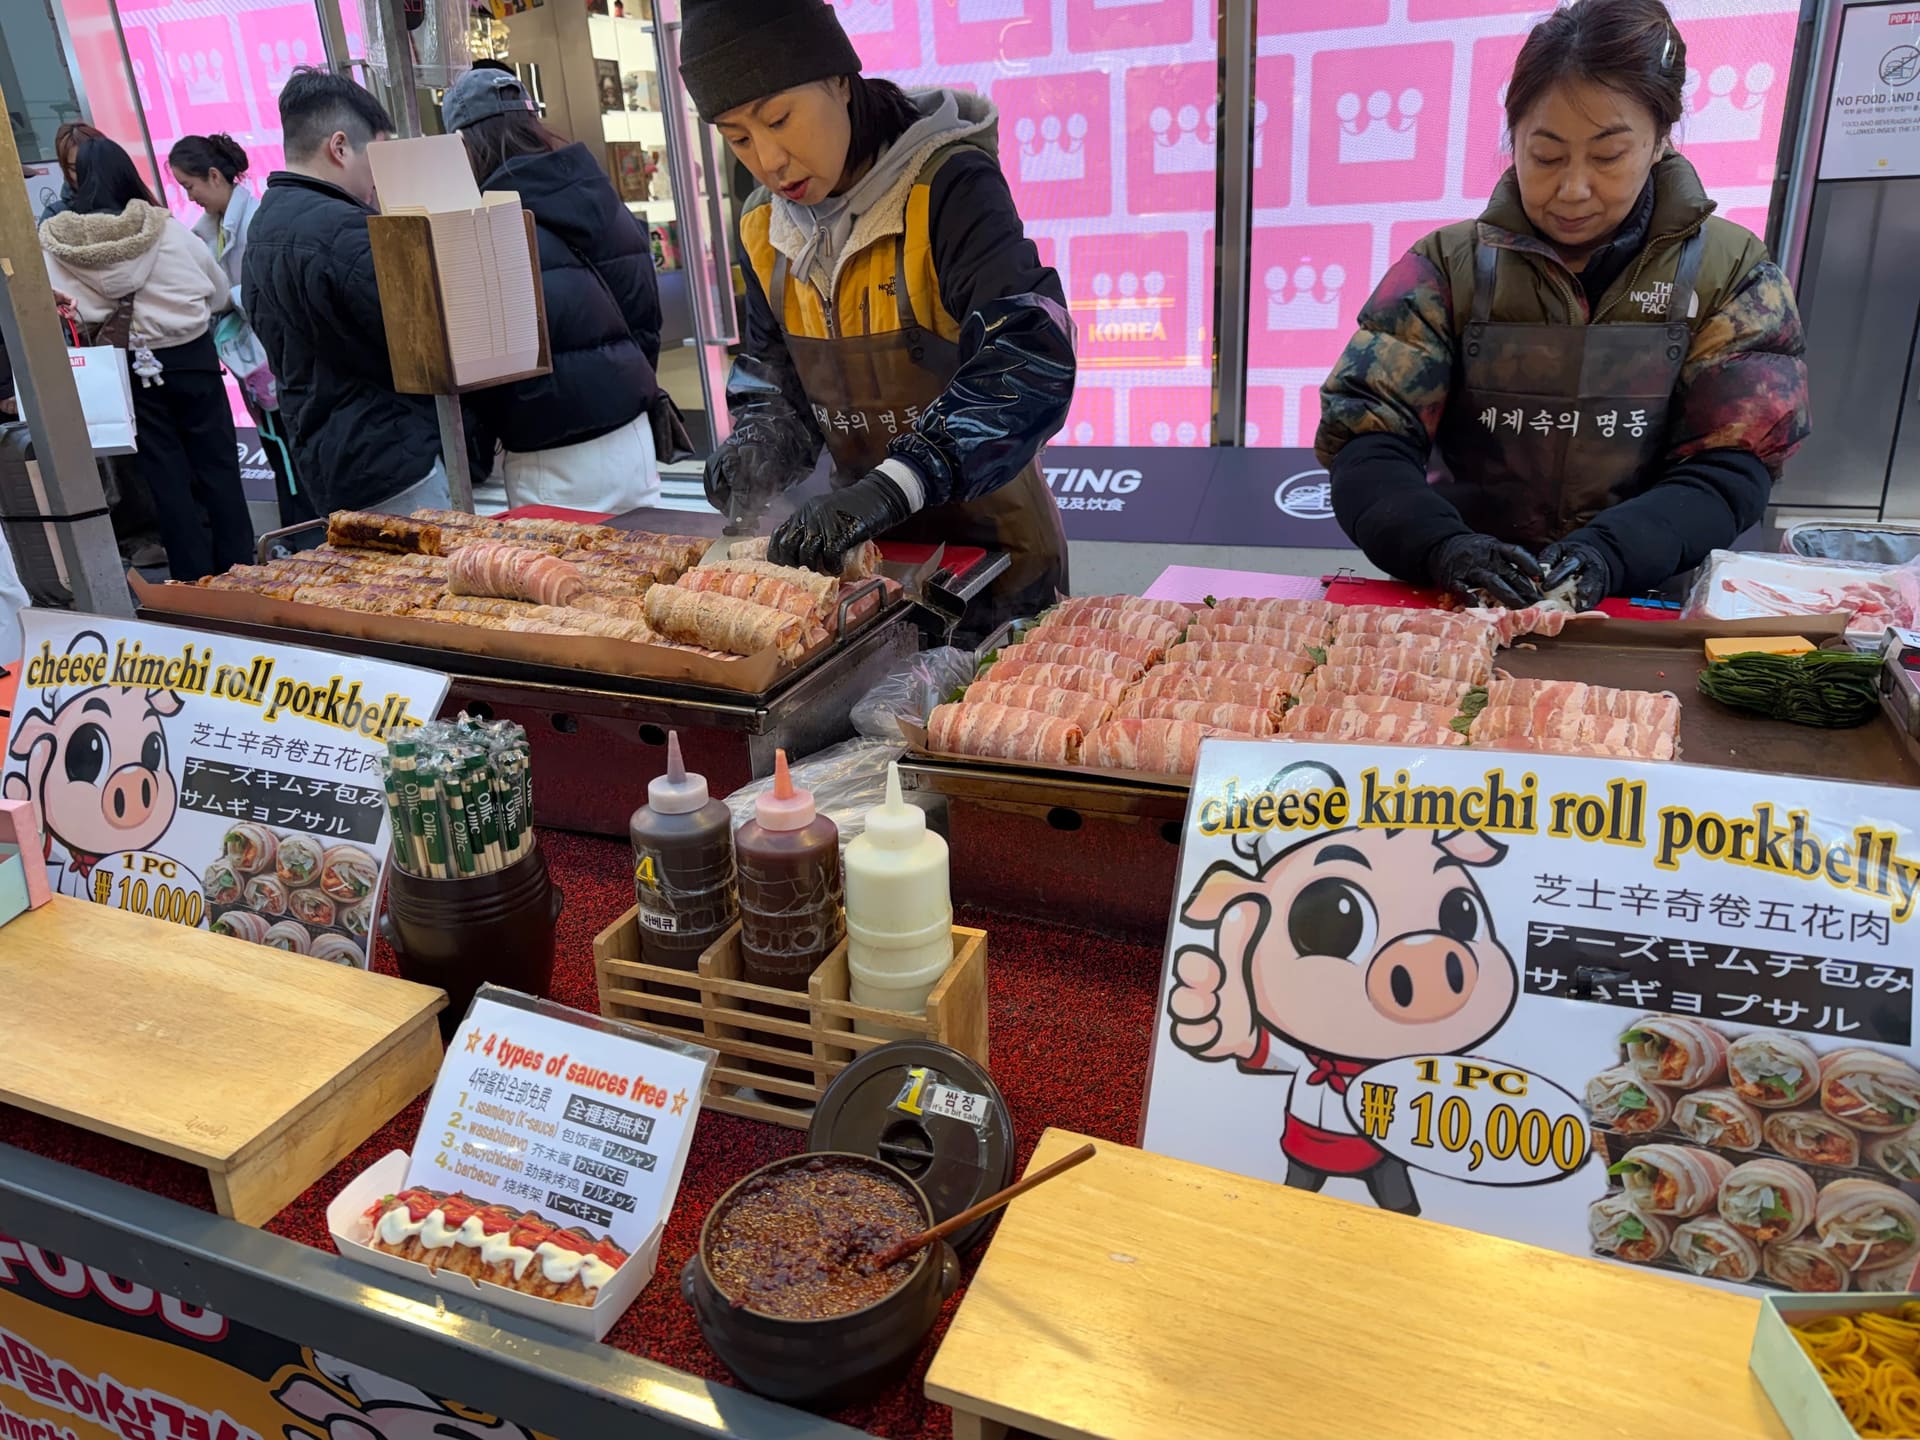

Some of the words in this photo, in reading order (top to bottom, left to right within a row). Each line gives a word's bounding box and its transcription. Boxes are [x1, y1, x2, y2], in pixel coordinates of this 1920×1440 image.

[1836, 96, 1853, 106] NO
[1855, 94, 1887, 105] FOOD
[1888, 92, 1914, 103] AND
[1641, 303, 1667, 314] FAC
[1088, 320, 1167, 342] KOREA
[1477, 406, 1580, 438] 세계속의
[1596, 409, 1648, 438] 명동
[27, 641, 108, 687] cheese
[111, 639, 210, 692] kimchi
[213, 657, 274, 703] roll
[185, 759, 384, 809] チーズキムチ包み
[181, 788, 351, 835] サムギョプサル
[123, 853, 135, 871] 1
[141, 855, 178, 879] PC
[1200, 779, 1348, 834] cheese
[1360, 768, 1538, 832] kimchi
[1549, 781, 1645, 845] roll
[1656, 803, 1920, 920] porkbelly
[635, 855, 657, 891] 4
[1532, 872, 1891, 946] 芝士辛奇卷五花肉
[1529, 924, 1913, 994] チーズキムチ包み
[483, 1032, 497, 1056] 4
[497, 1037, 545, 1073] types
[545, 1053, 570, 1078] of
[565, 1062, 630, 1097] sauces
[630, 1075, 669, 1110] free
[897, 1067, 929, 1116] 1
[1414, 1057, 1441, 1084] 1
[1453, 1062, 1528, 1097] PC
[567, 1099, 651, 1141] 全種類無料
[1361, 1081, 1398, 1140] ₩
[1410, 1091, 1585, 1171] 10,000
[605, 1141, 656, 1169] サムジャン
